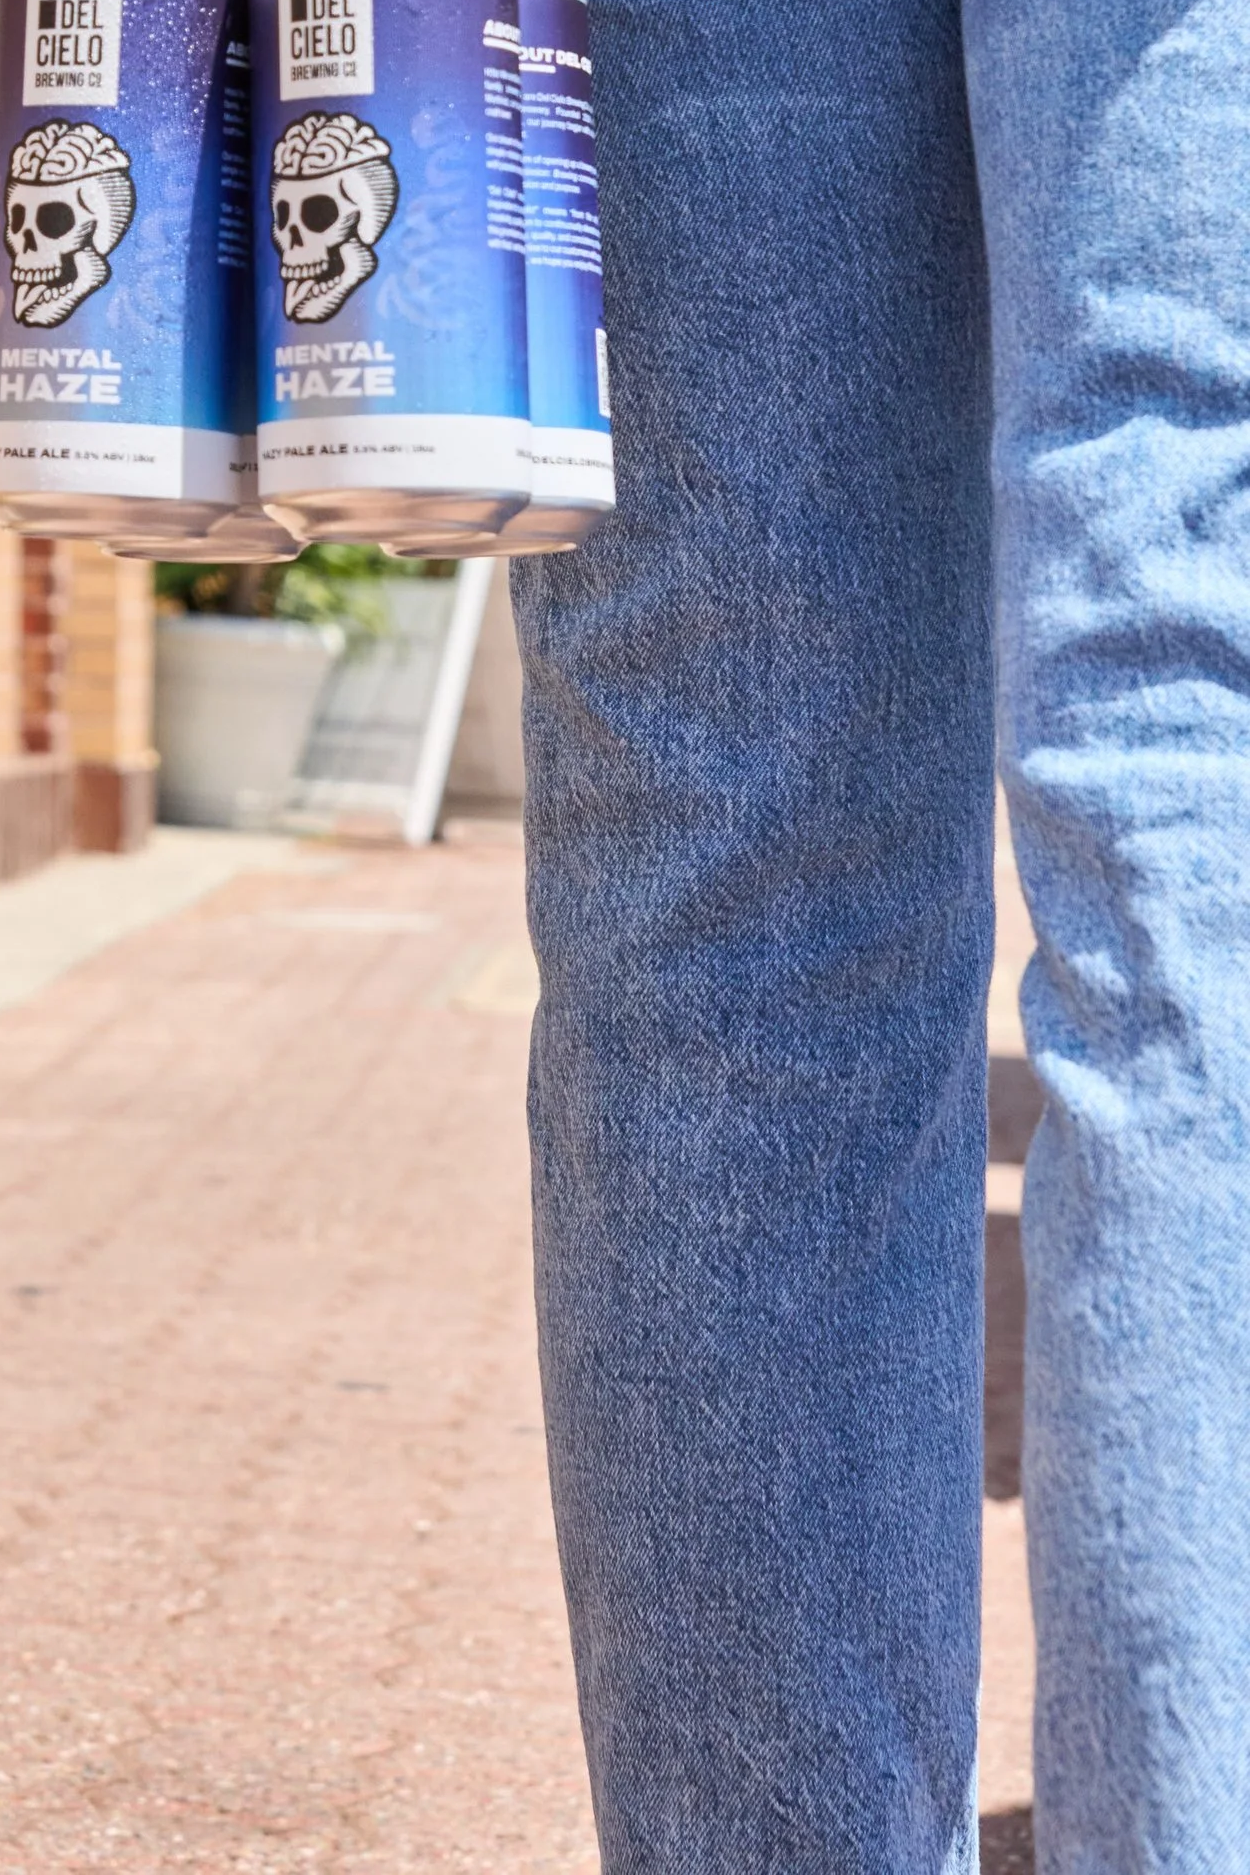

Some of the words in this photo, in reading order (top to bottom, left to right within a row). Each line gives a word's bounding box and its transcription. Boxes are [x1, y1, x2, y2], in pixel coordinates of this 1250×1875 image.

[61, 0, 104, 29] DEL
[37, 34, 103, 67] CIELO
[291, 23, 355, 60] CIELO
[34, 72, 85, 88] BREWING
[291, 62, 339, 81] BREWING
[0, 347, 123, 370] MENTAL
[275, 340, 395, 368] MENTAL
[0, 374, 121, 405] HAZE
[275, 366, 396, 402] HAZE
[3, 447, 36, 458] PALE
[40, 448, 70, 459] ALE
[284, 445, 315, 456] PALE
[320, 444, 348, 455] ALE
